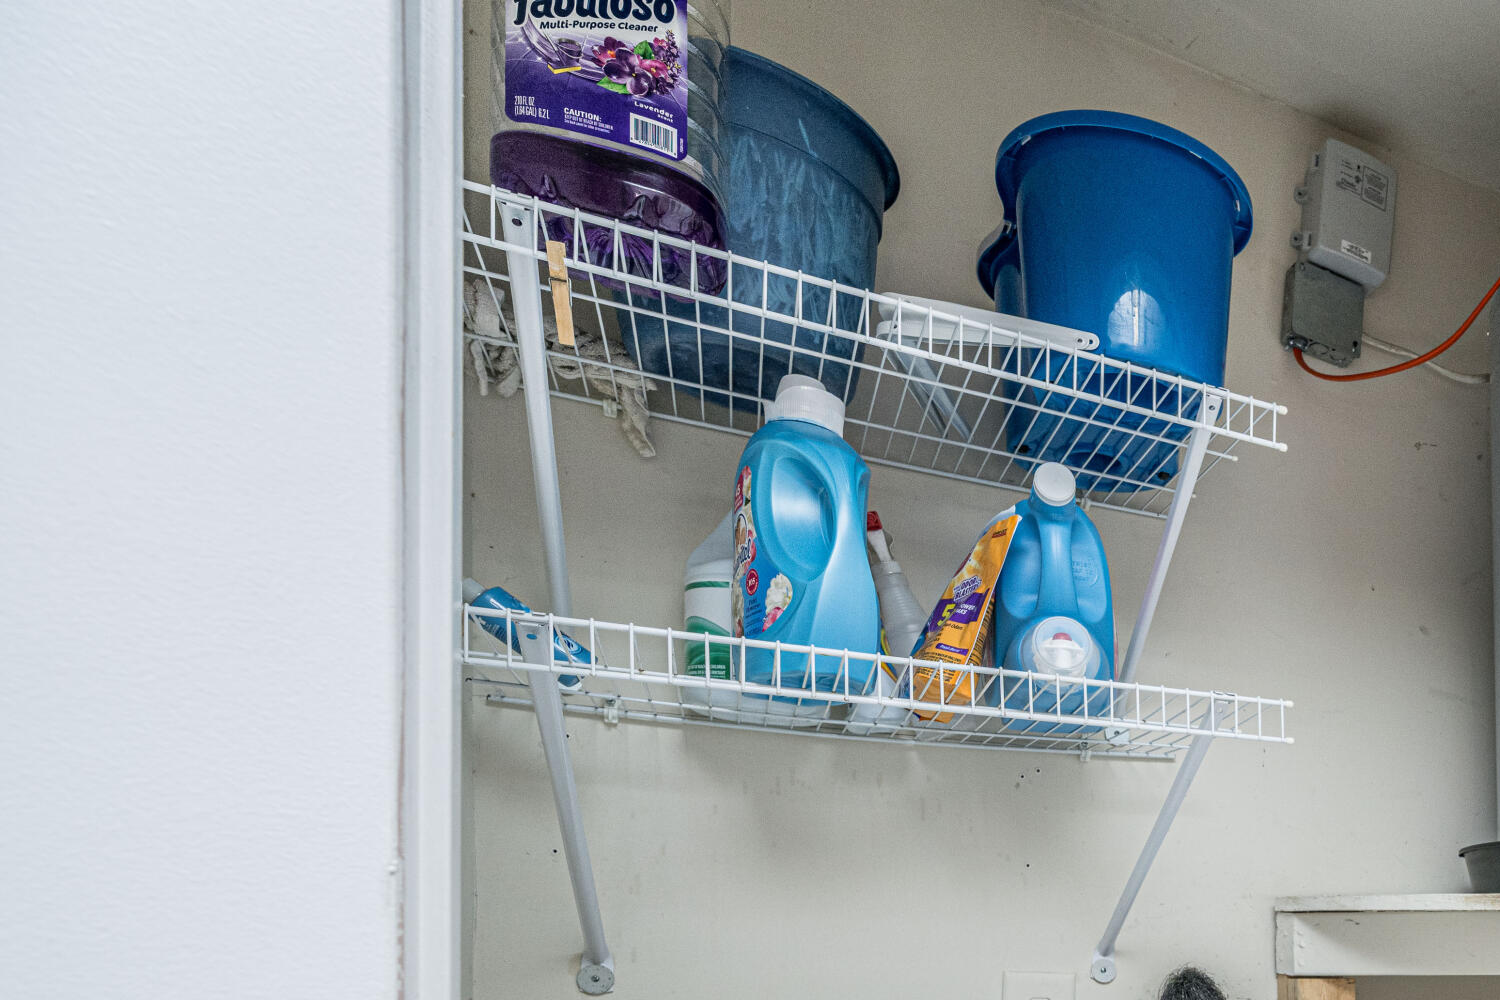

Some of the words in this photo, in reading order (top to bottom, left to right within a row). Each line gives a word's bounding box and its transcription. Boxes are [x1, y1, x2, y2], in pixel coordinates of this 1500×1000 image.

[539, 20, 615, 31] Multi-Purpose
[618, 21, 659, 33] Cleaner
[563, 107, 602, 122] CAUTION:
[634, 100, 674, 118] Lavender
[937, 603, 956, 626] 5
